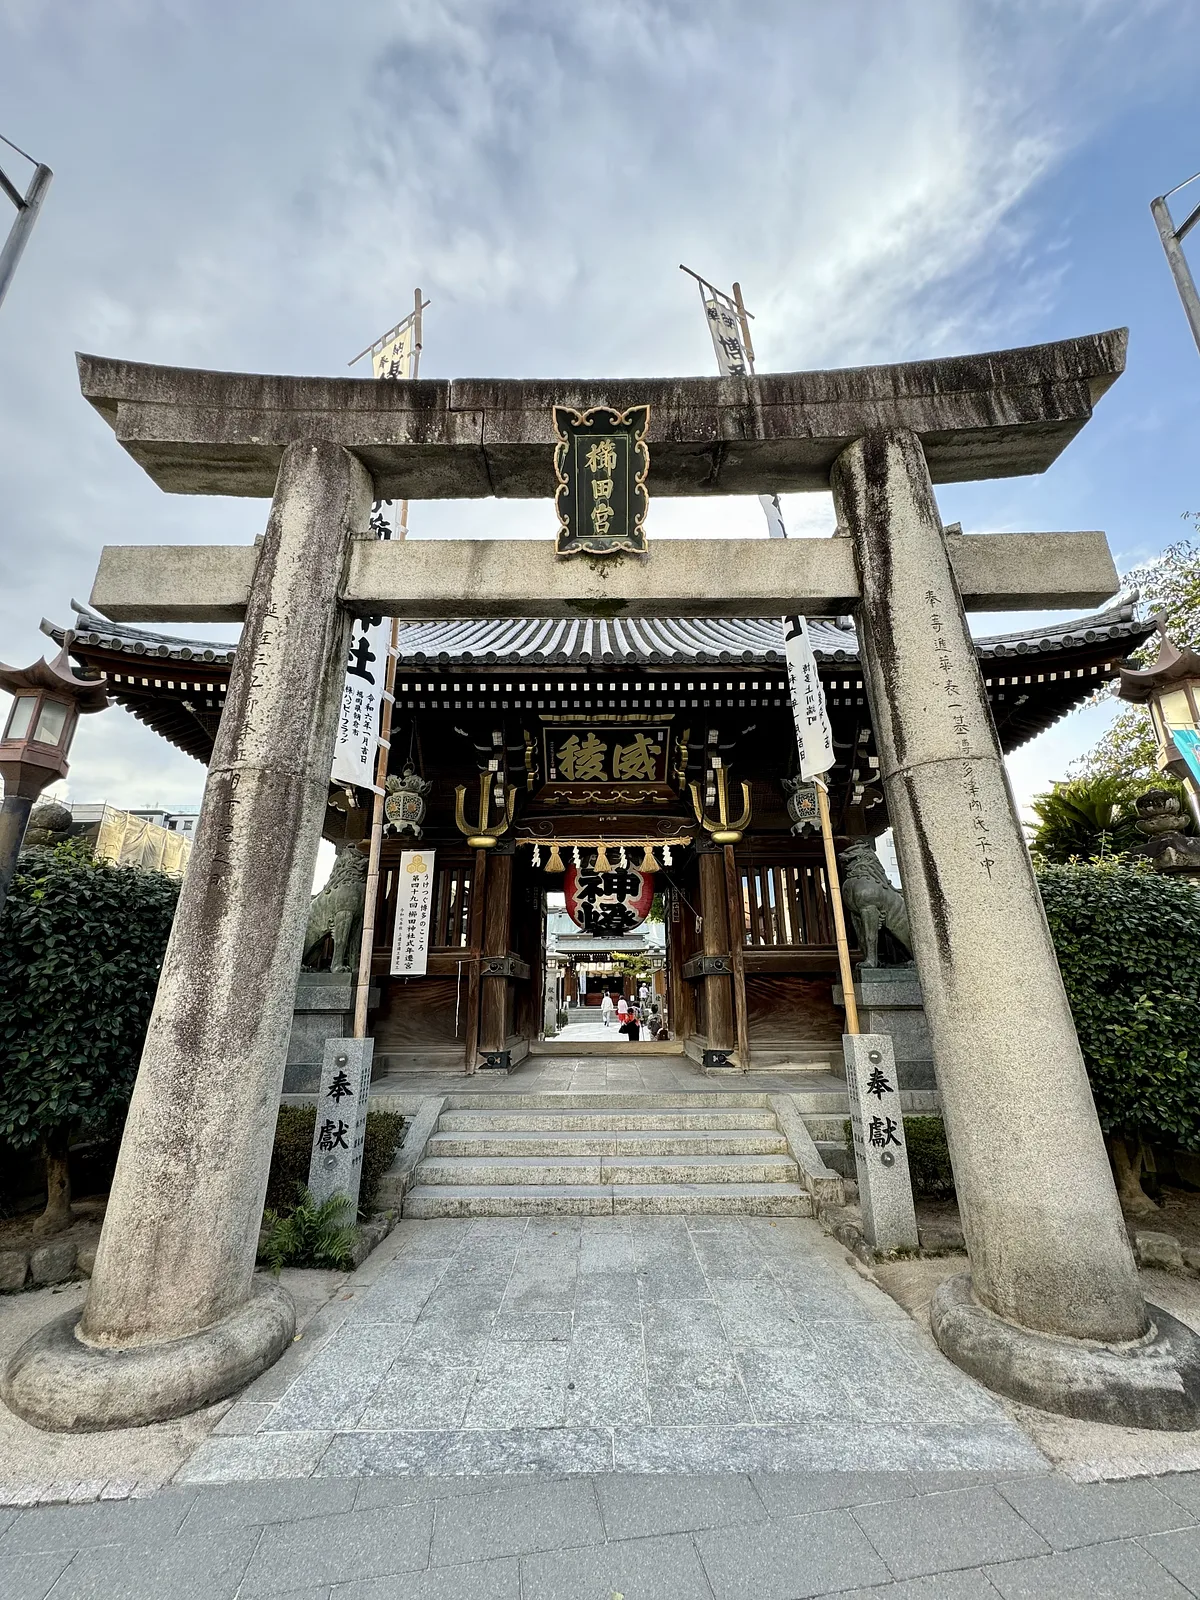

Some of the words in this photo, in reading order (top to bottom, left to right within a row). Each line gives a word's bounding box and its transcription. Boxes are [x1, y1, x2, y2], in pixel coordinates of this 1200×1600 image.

[584, 438, 618, 534] 櫛田宮
[361, 693, 375, 764] 令和六年一月吉日
[418, 873, 429, 951] うけつぐ博多のこころ
